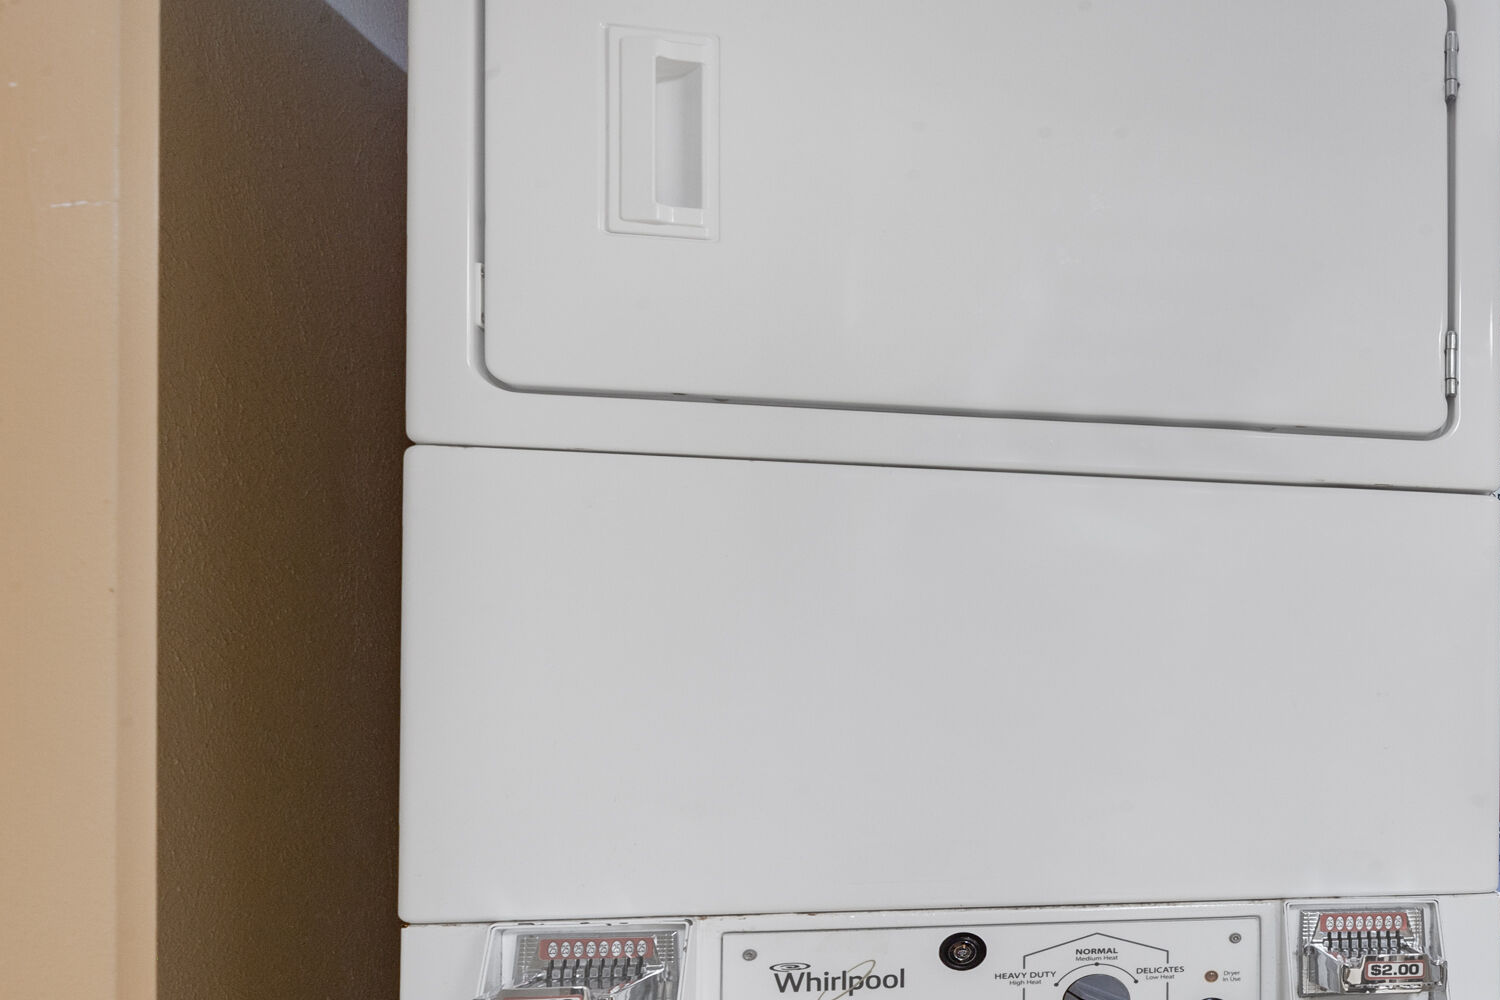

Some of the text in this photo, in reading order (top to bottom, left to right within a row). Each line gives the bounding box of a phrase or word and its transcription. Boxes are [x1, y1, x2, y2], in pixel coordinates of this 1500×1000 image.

[1076, 948, 1118, 956] NORMAL
[1136, 966, 1185, 975] DELICATES
[1371, 964, 1420, 976] $2.00
[995, 971, 1057, 980] HEAVY DUTY
[774, 968, 905, 997] Whirlpool
